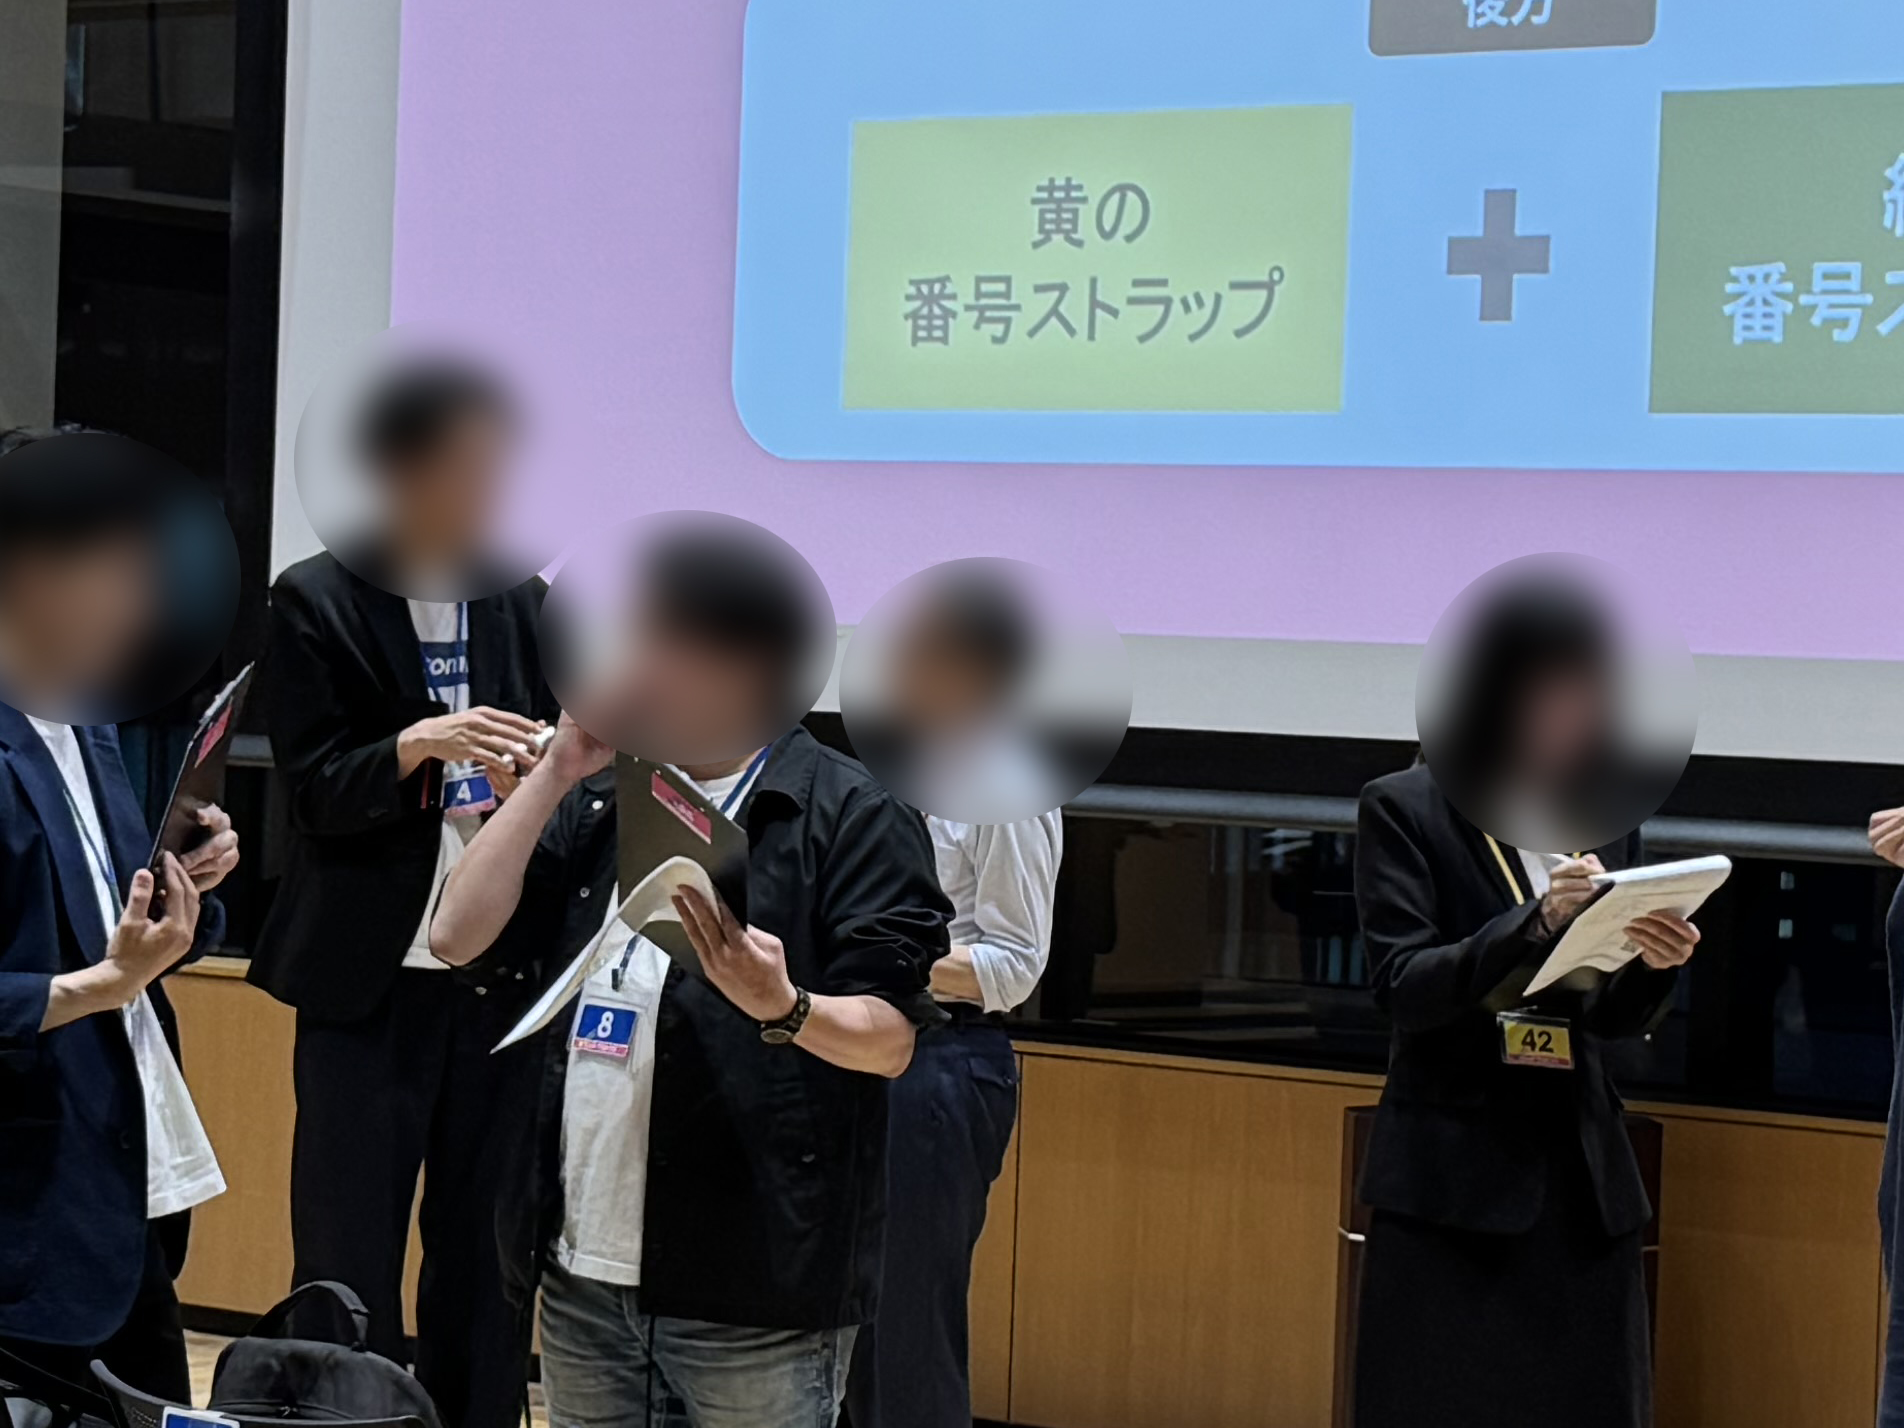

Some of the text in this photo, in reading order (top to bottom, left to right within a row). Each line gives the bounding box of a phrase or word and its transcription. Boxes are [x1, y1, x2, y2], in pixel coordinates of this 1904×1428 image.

[1030, 176, 1151, 251] 黄の
[903, 265, 1286, 349] 番号ストラップ
[597, 1011, 614, 1038] 8
[1521, 1028, 1555, 1053] 42
